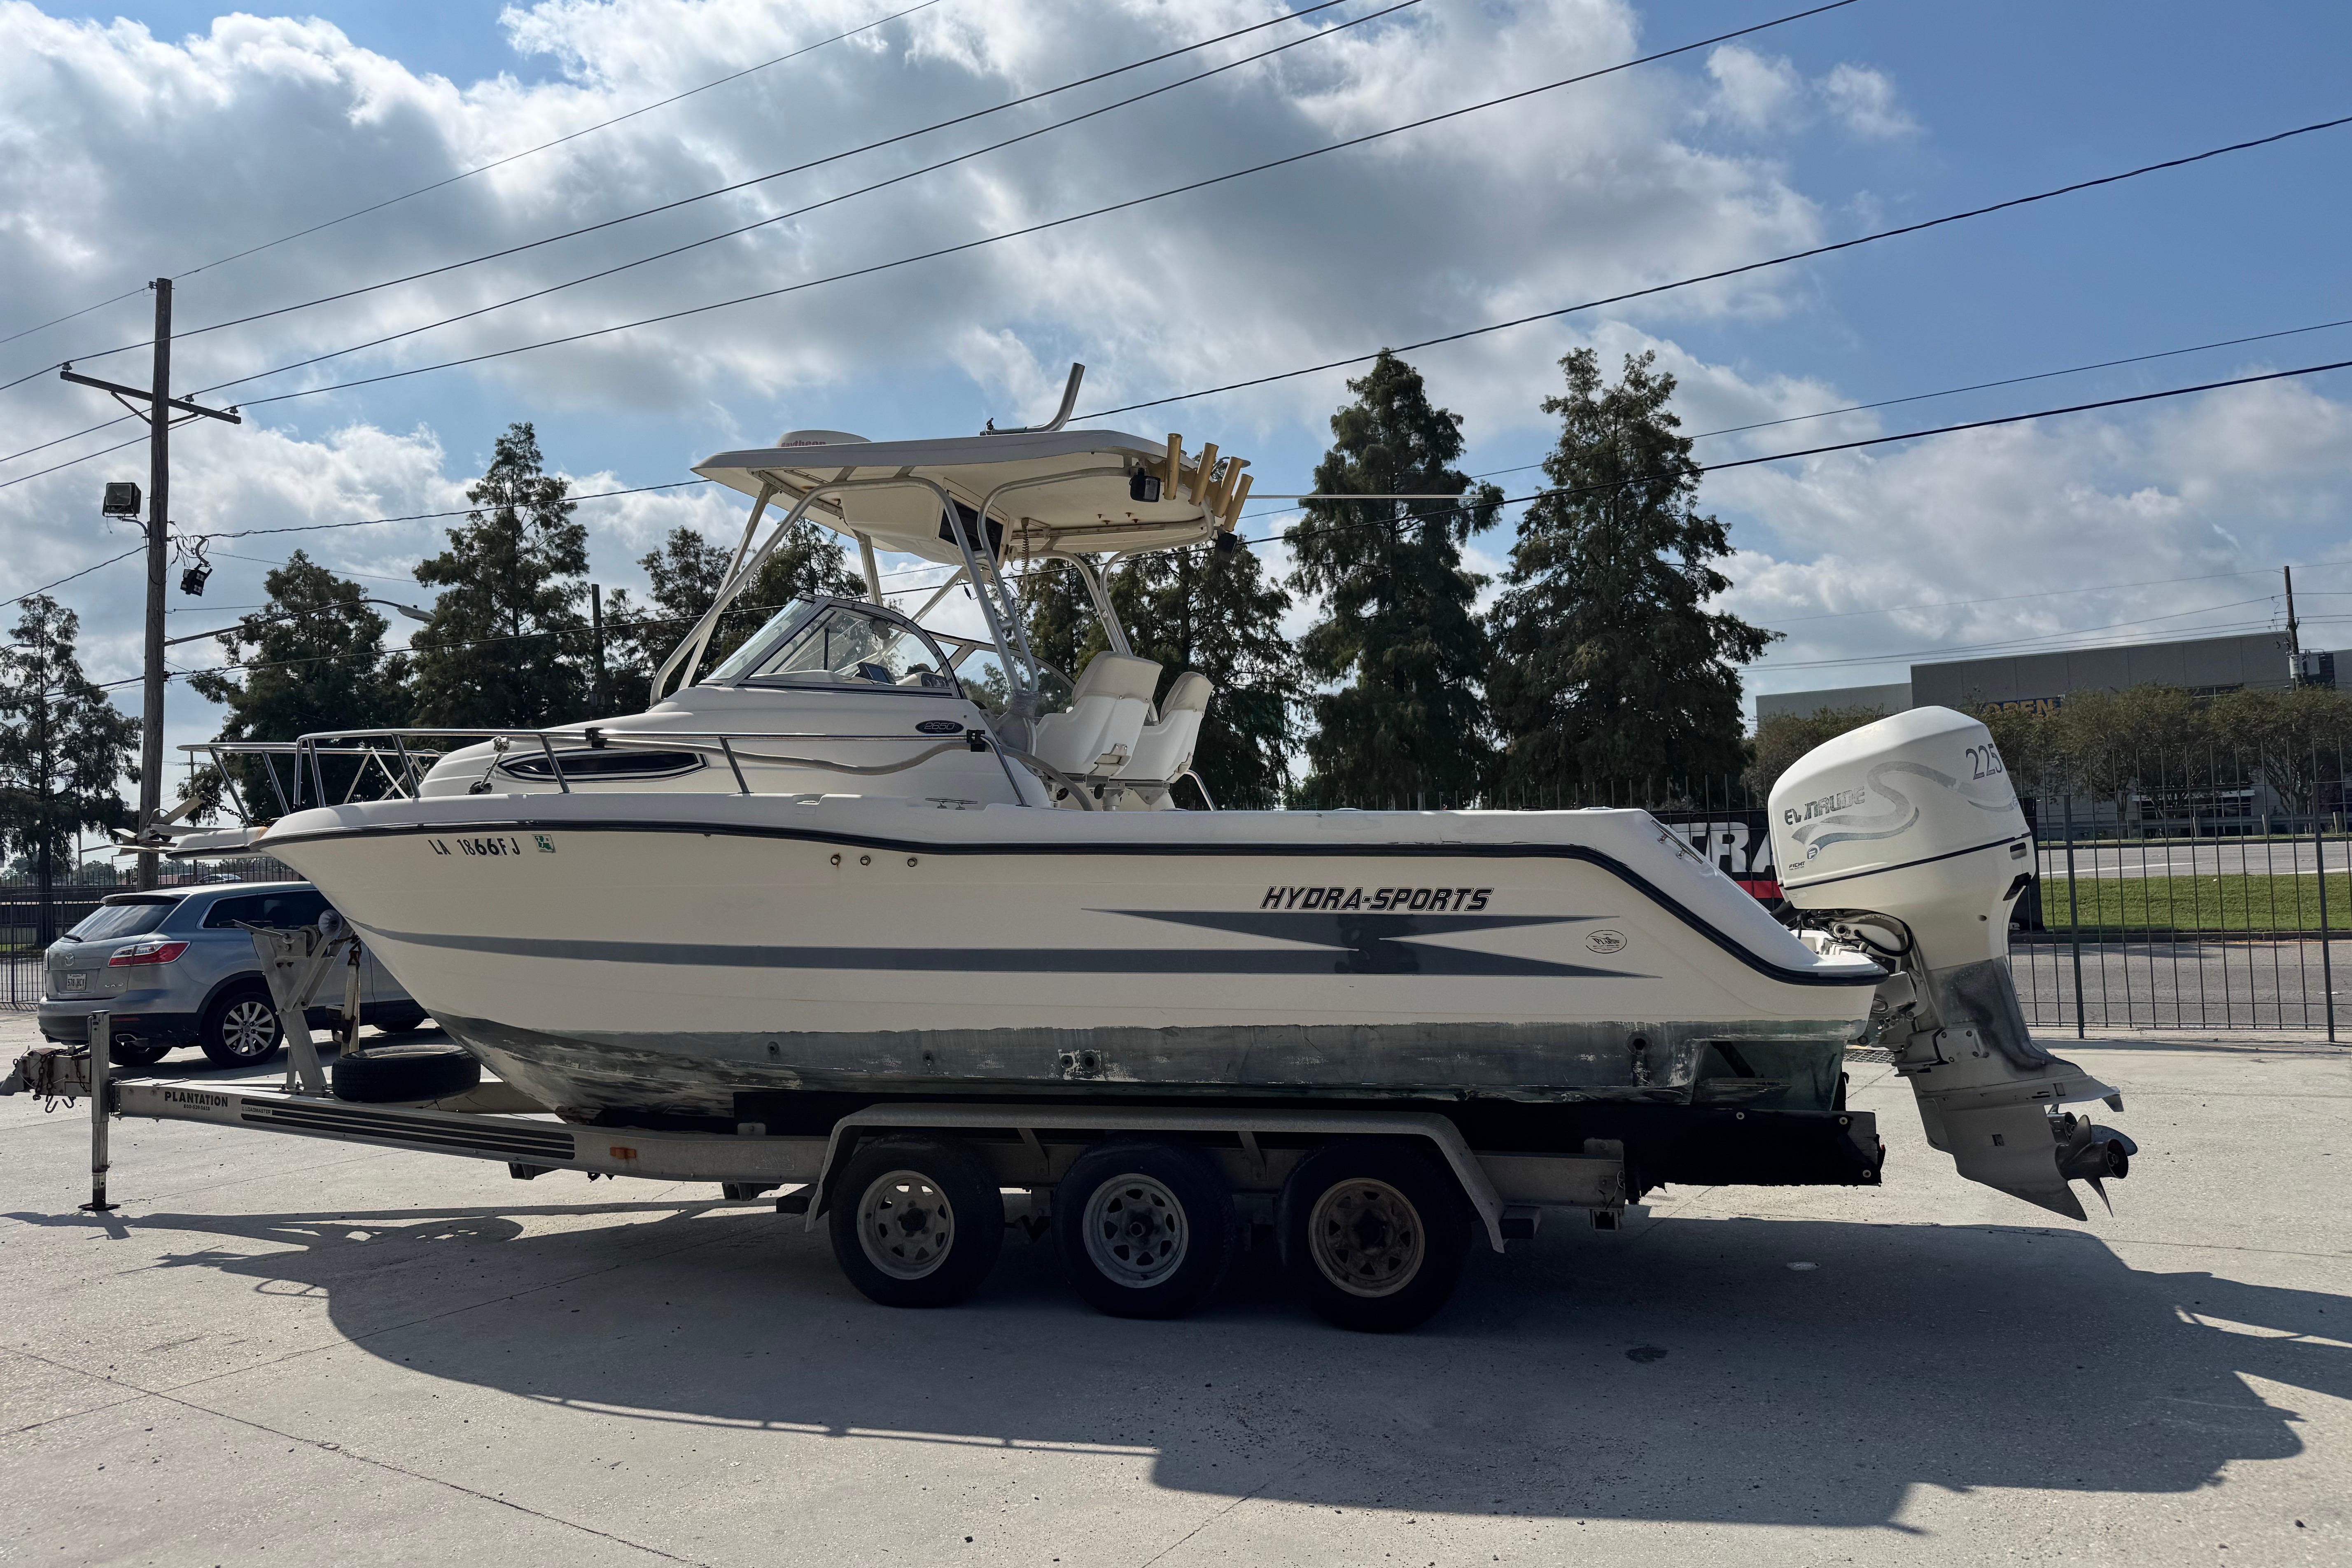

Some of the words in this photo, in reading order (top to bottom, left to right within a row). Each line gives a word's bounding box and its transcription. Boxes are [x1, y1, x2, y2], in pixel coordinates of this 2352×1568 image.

[1965, 743, 2002, 780] 225
[427, 839, 452, 855] LA
[1260, 886, 1494, 912] HYDRA-SPORTS
[165, 1091, 229, 1108] PLANTATION
